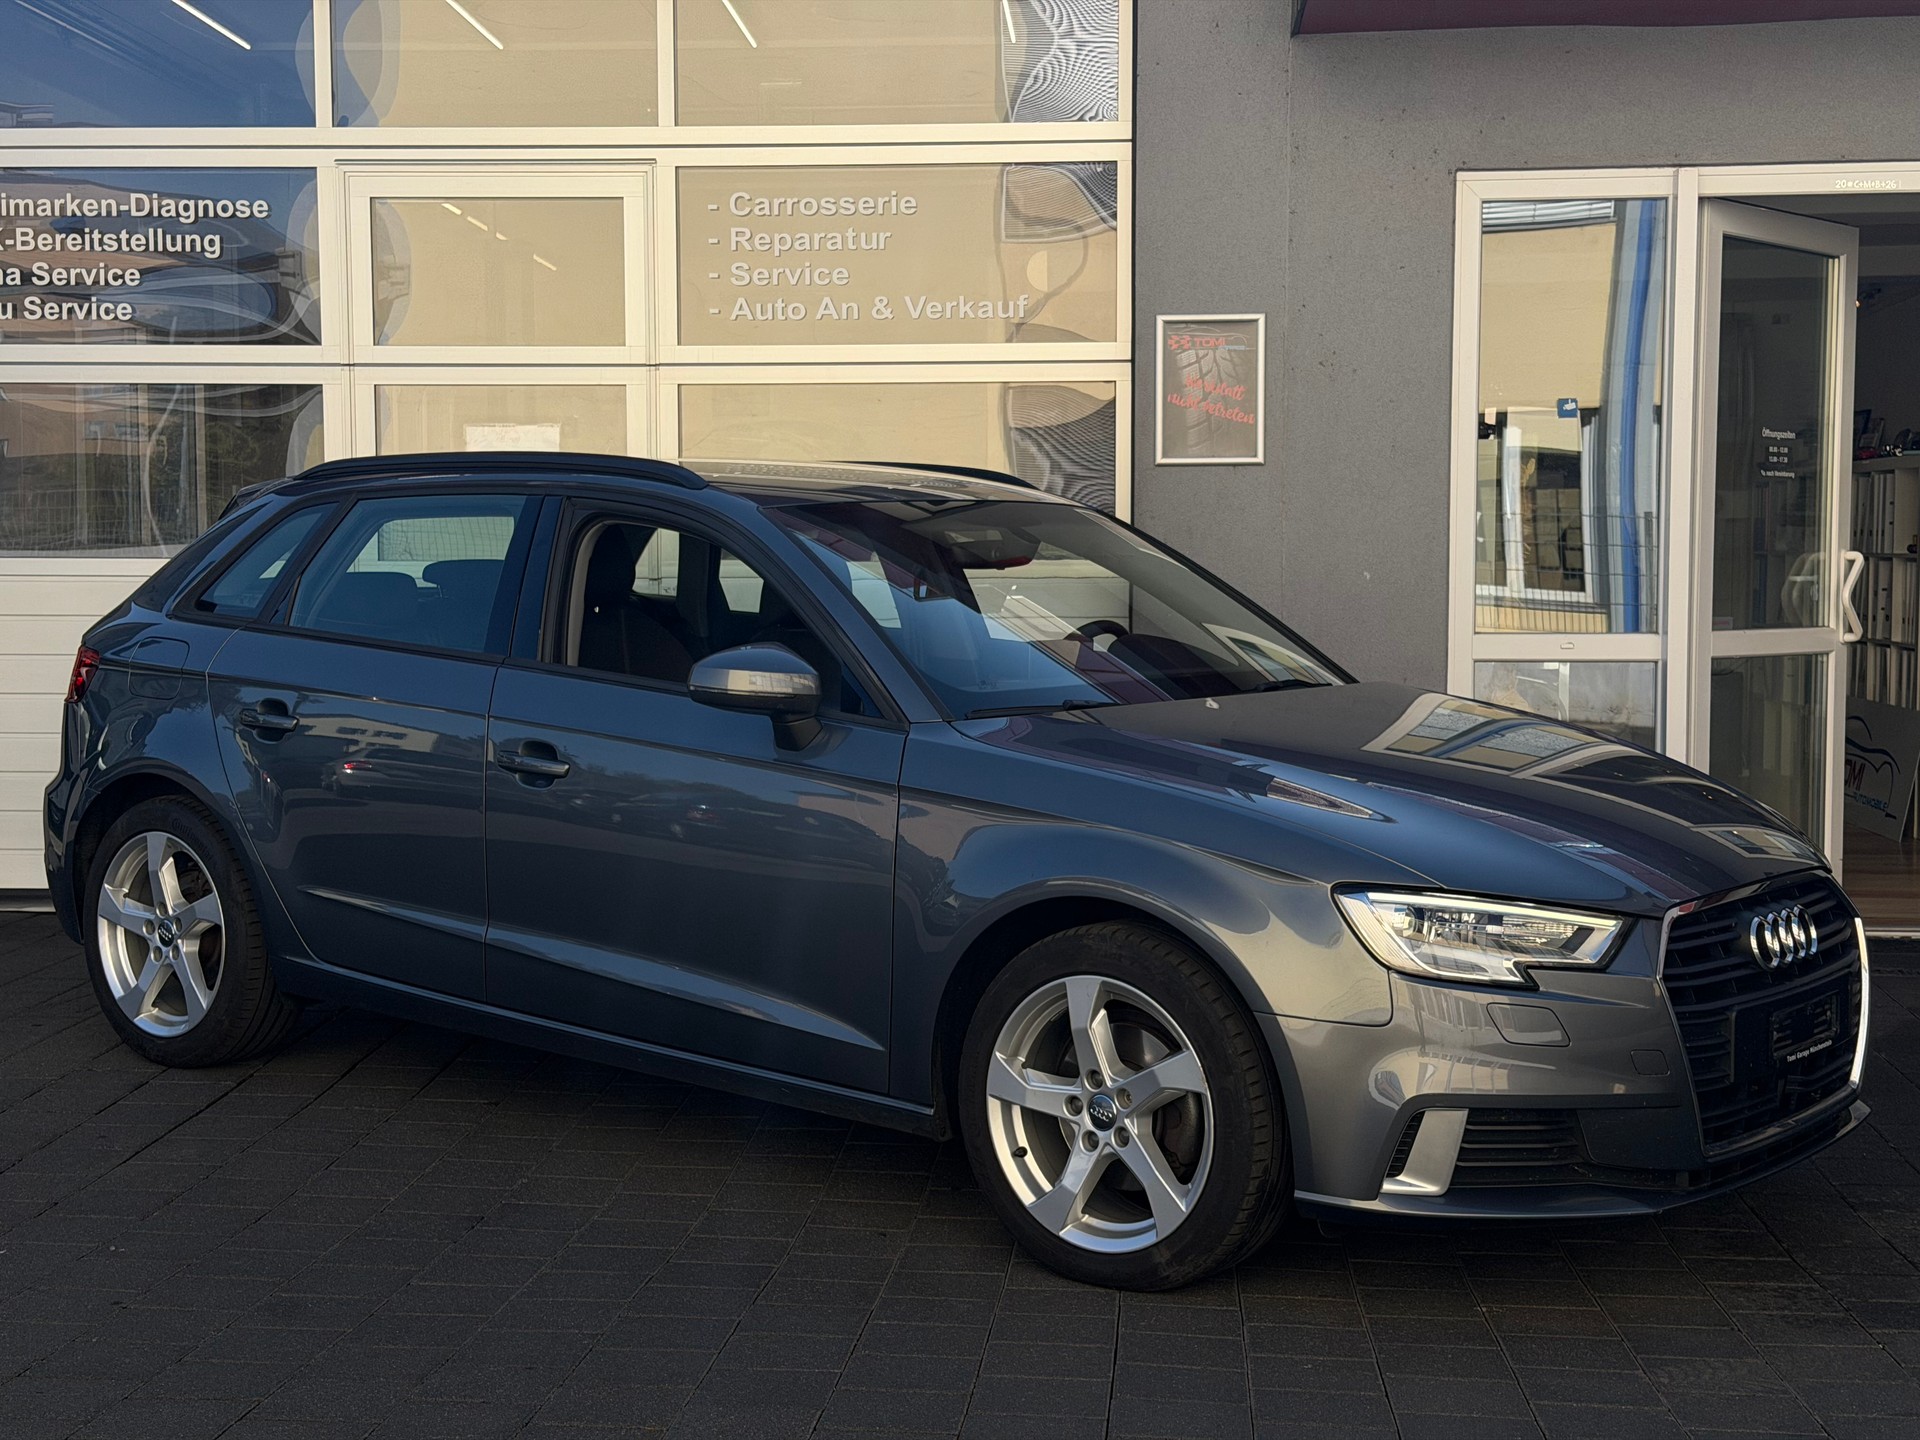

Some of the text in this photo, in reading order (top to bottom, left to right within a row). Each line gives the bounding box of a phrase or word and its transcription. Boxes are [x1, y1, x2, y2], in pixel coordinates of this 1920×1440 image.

[0, 192, 270, 224] imarken-Diagnose
[729, 191, 918, 217] Carrosserie
[729, 226, 892, 257] Reparatur
[0, 261, 142, 286] a Service
[730, 261, 850, 287] Service
[23, 295, 134, 320] Service
[730, 296, 807, 322] Auto
[815, 296, 860, 321] An
[871, 295, 895, 321] &
[903, 294, 1029, 320] Verkauf
[1194, 336, 1226, 348] TOMI
[1202, 399, 1256, 424] betreten
